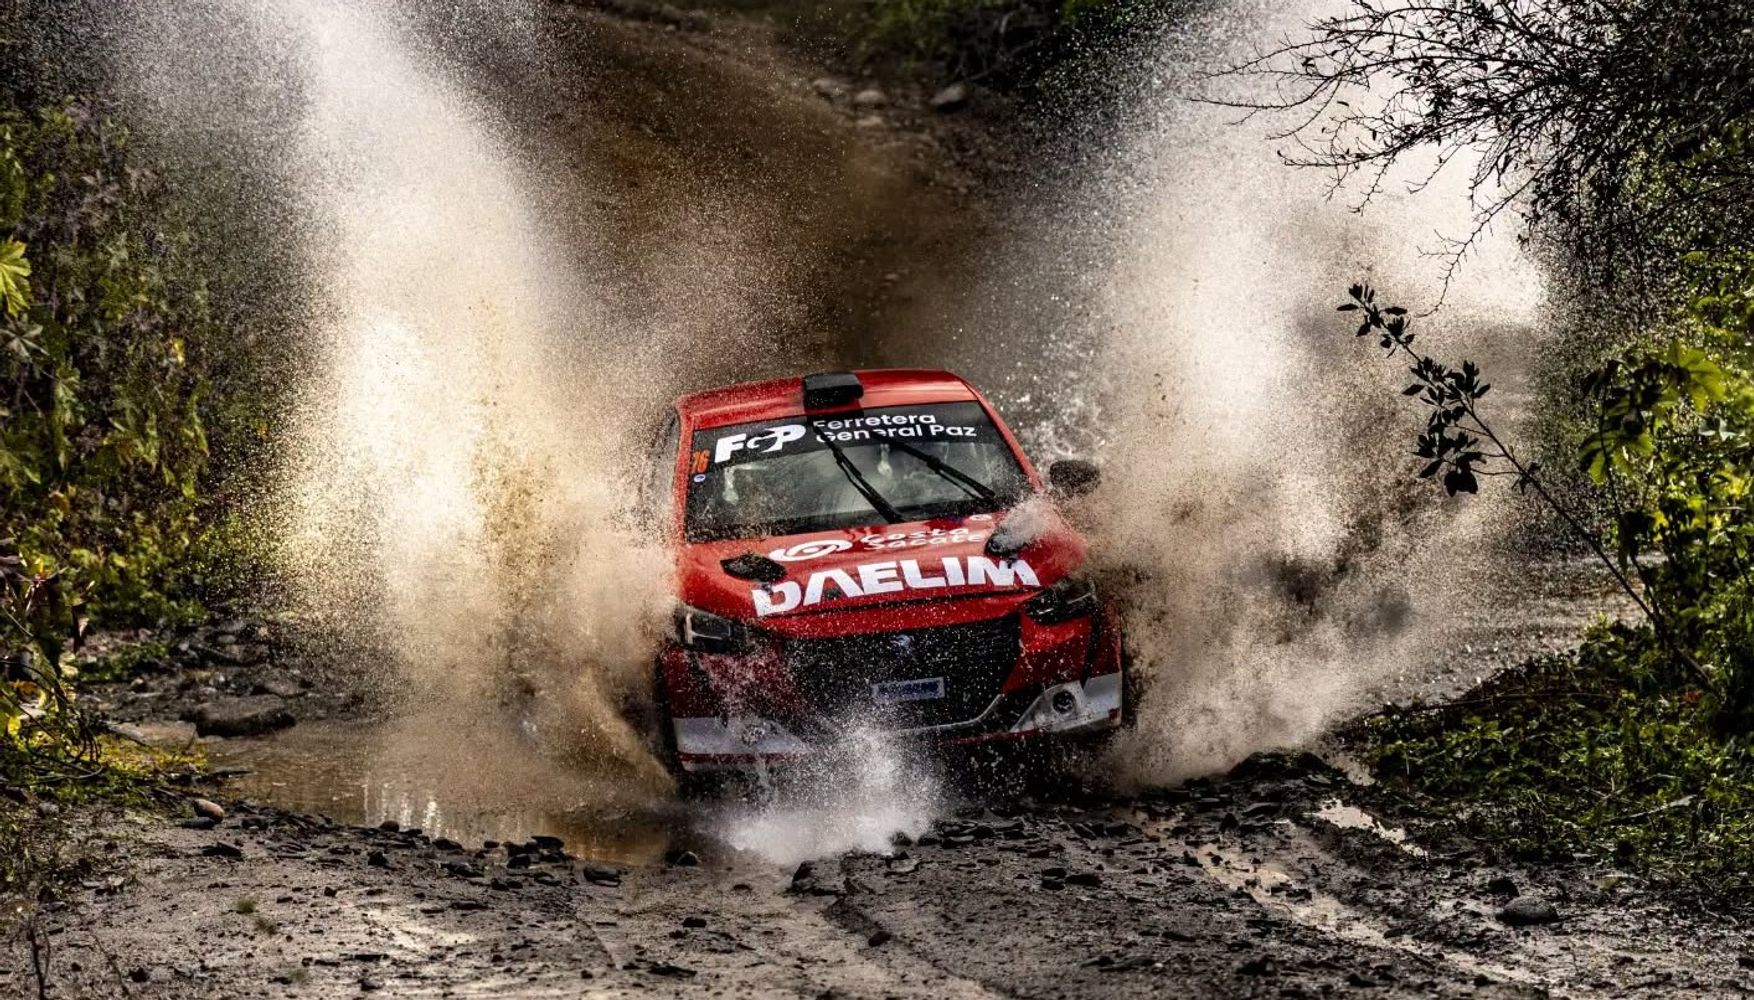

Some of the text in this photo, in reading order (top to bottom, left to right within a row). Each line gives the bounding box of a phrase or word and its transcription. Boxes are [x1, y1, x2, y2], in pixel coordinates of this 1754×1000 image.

[813, 414, 936, 430] Ferretera
[930, 424, 977, 437] Paz
[861, 528, 959, 544] Costa
[752, 556, 1040, 616] DAELIM
